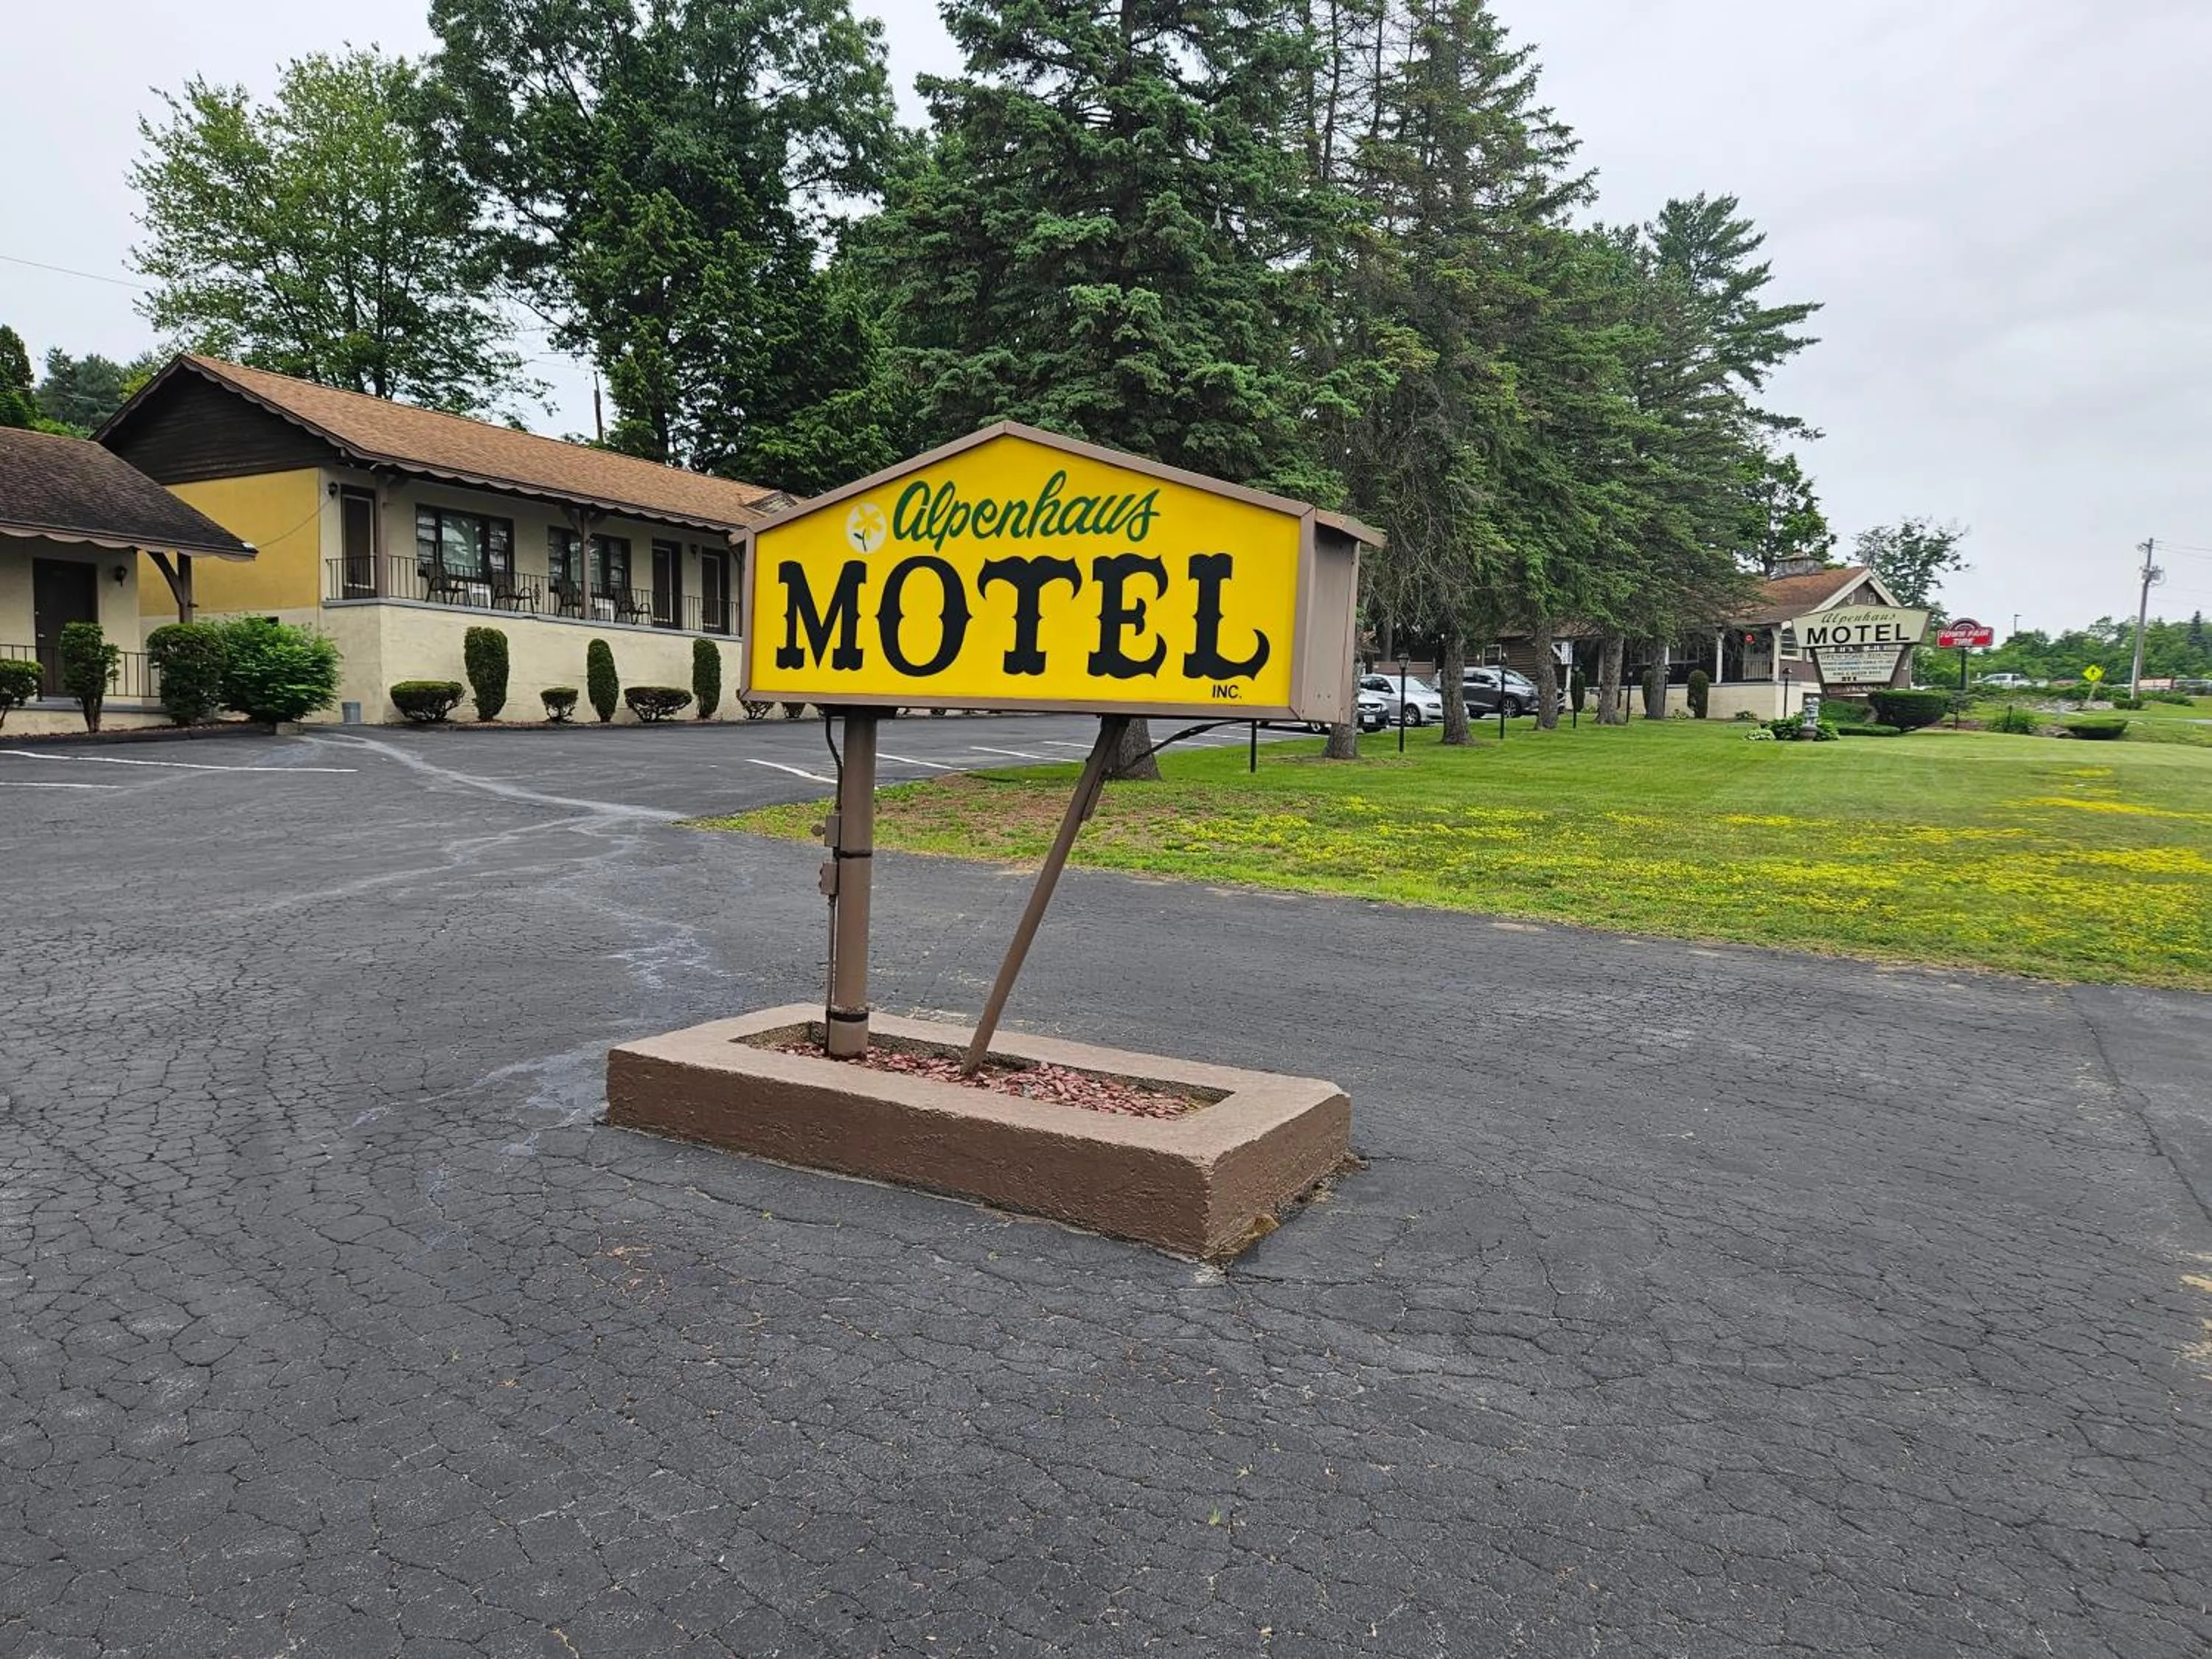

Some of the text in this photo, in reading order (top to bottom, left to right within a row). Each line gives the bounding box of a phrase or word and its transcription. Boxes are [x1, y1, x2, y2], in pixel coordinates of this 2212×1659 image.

[892, 469, 1161, 552] Alpenhaus
[776, 552, 1270, 681] MOTEL
[1821, 612, 1896, 625] Alpenhaus
[1807, 624, 1910, 644] MOTEL
[1211, 684, 1242, 699] INC.
